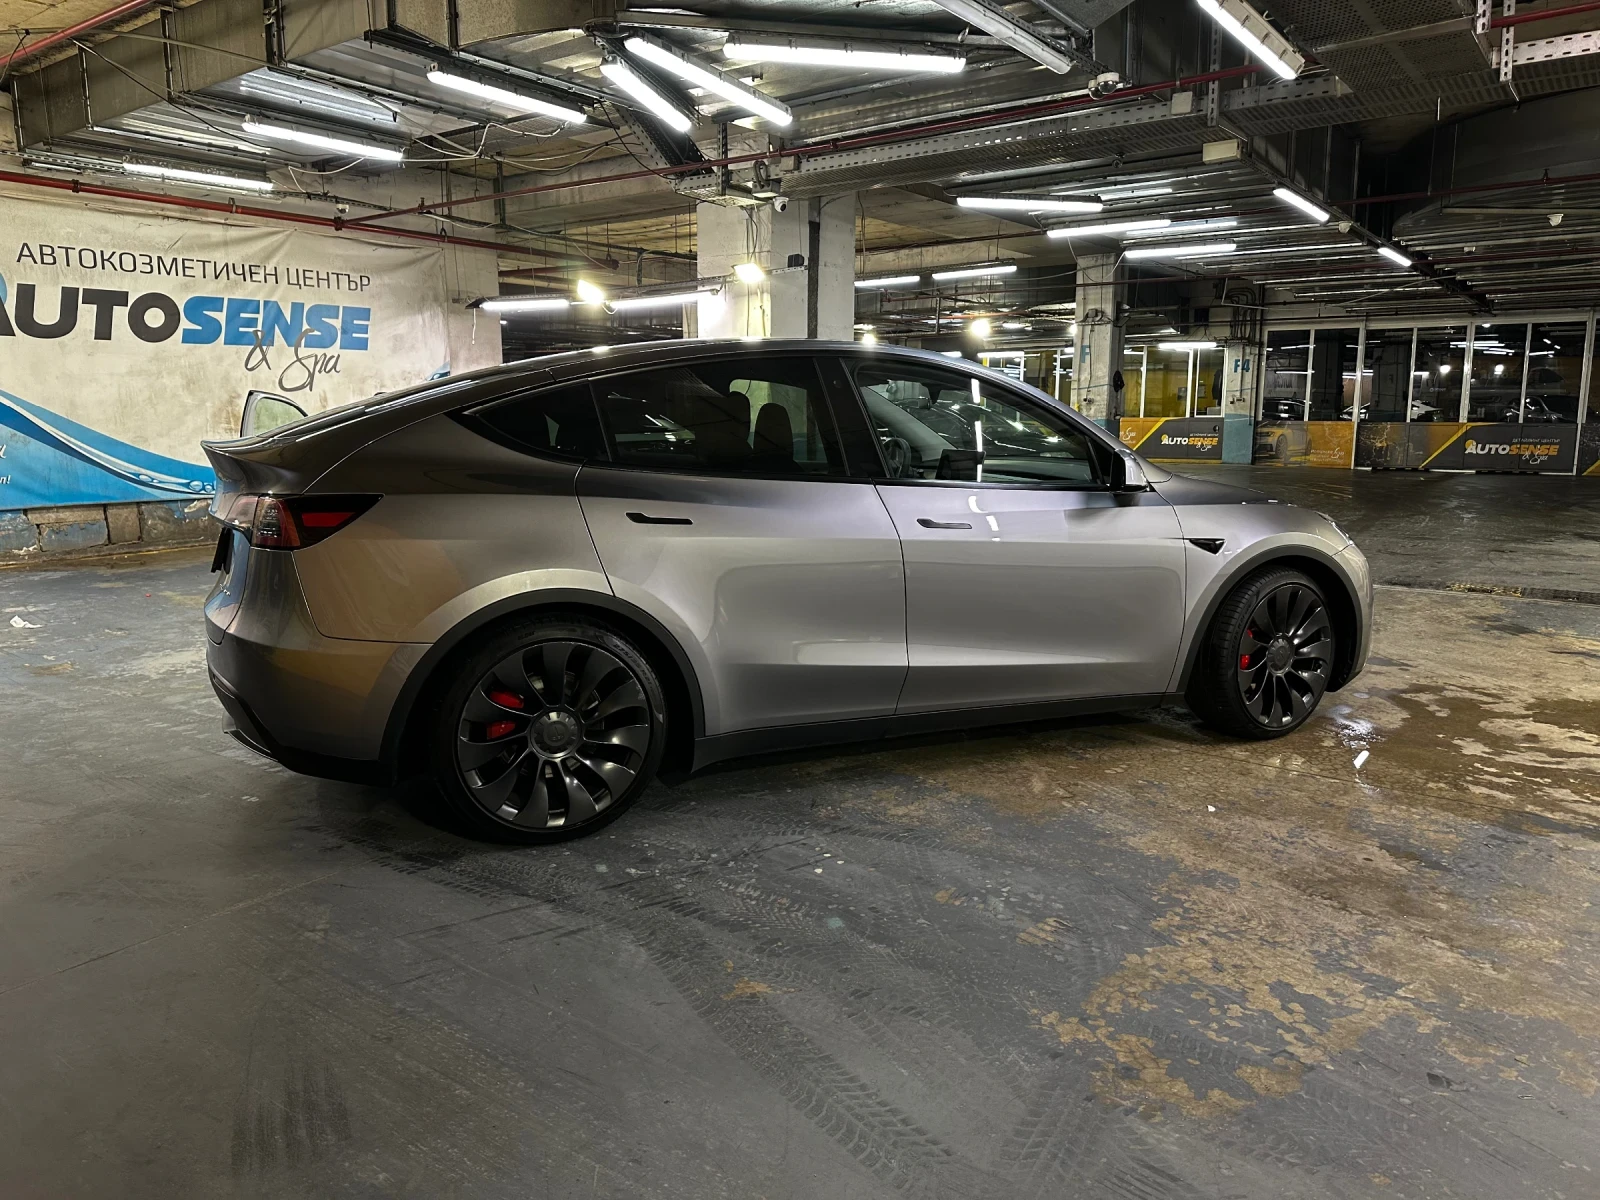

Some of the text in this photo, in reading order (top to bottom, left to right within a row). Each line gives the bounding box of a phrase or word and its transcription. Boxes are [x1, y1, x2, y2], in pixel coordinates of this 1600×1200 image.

[16, 242, 372, 293] АВТОКОЗМЕТИЧЕН ЦЕНТЪР
[244, 328, 341, 392] & Spa
[1233, 358, 1251, 373] F4
[1161, 436, 1219, 445] AUTOSENSE
[1465, 442, 1559, 455] AUTOSENSE
